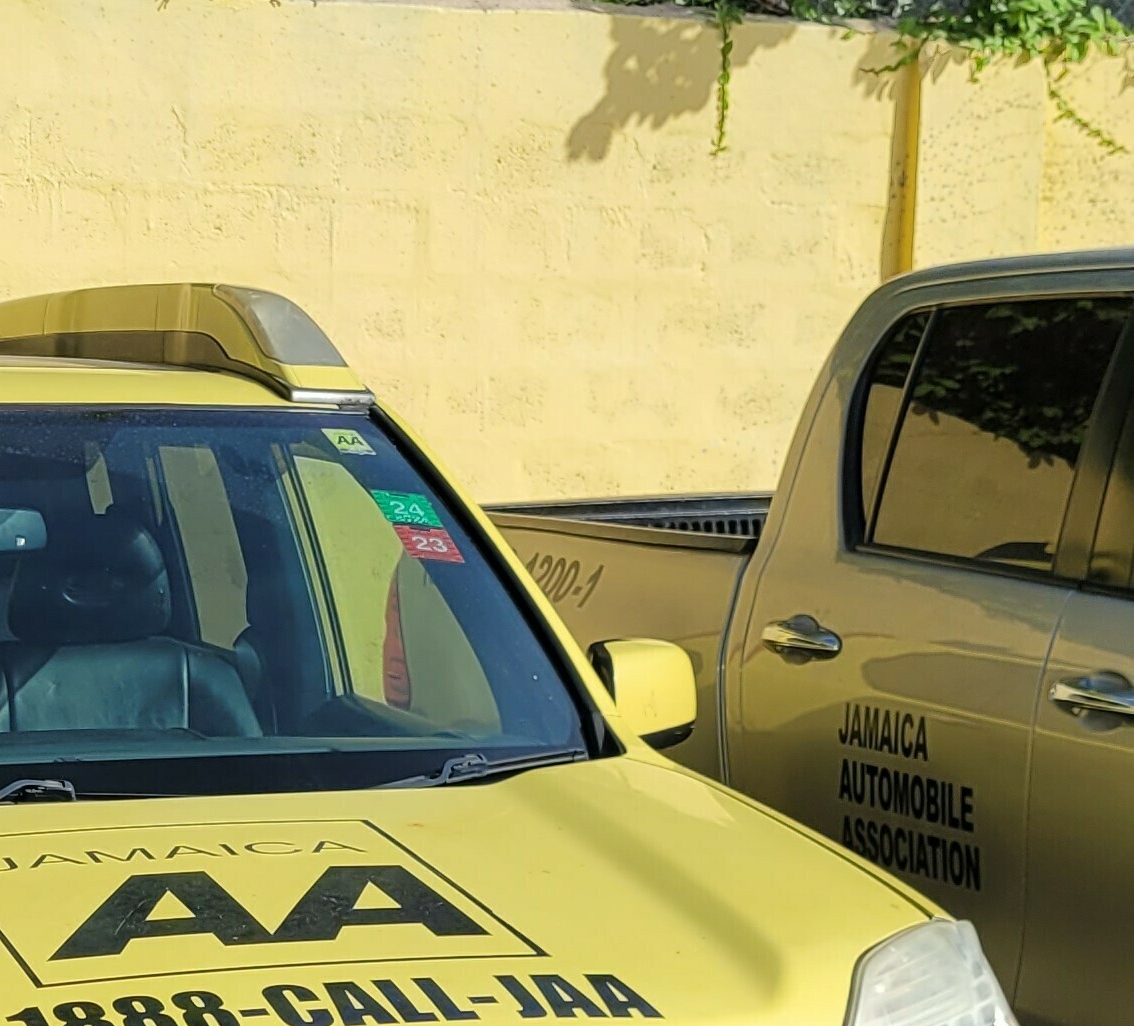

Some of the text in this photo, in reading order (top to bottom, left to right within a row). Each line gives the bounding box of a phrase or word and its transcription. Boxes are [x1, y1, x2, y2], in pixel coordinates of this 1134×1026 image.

[337, 435, 364, 446] AA
[390, 501, 425, 516] 24
[412, 536, 448, 552] 23
[838, 702, 929, 761] JAMAICA
[839, 758, 974, 832] AUTOMOBILE
[842, 815, 981, 891] ASSOCIATION
[47, 865, 491, 961] AA
